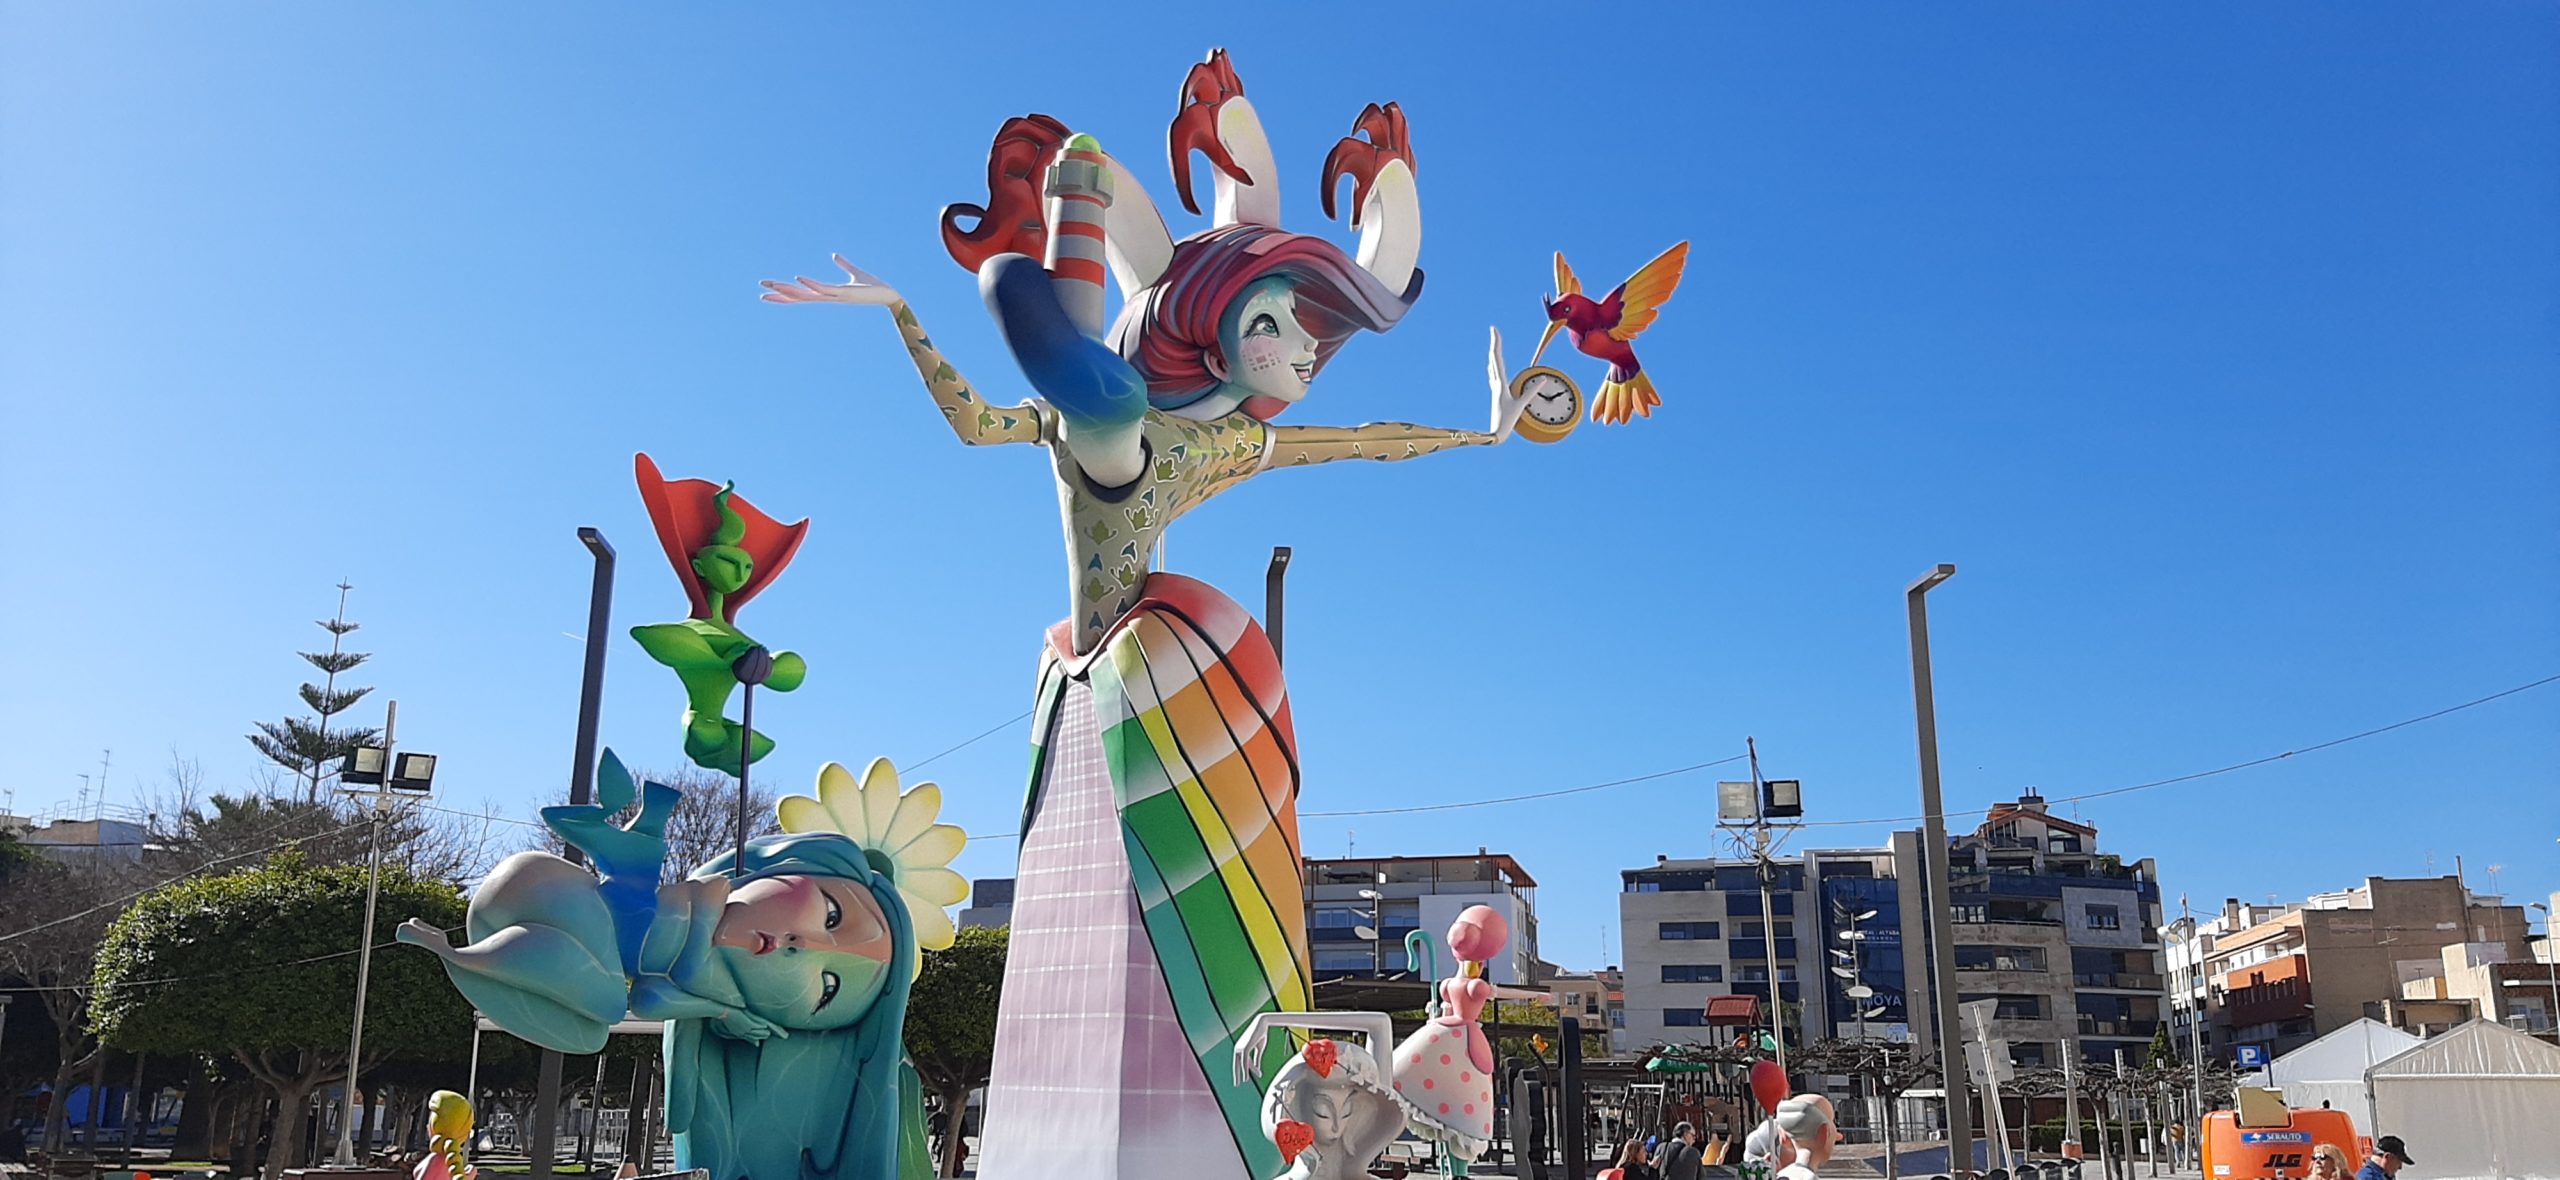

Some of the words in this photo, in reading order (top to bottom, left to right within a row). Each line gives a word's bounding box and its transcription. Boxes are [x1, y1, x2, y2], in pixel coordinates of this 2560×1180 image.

[1863, 995, 1902, 1006] MOYA
[2241, 1048, 2256, 1064] P
[2263, 1154, 2302, 1168] JLG
